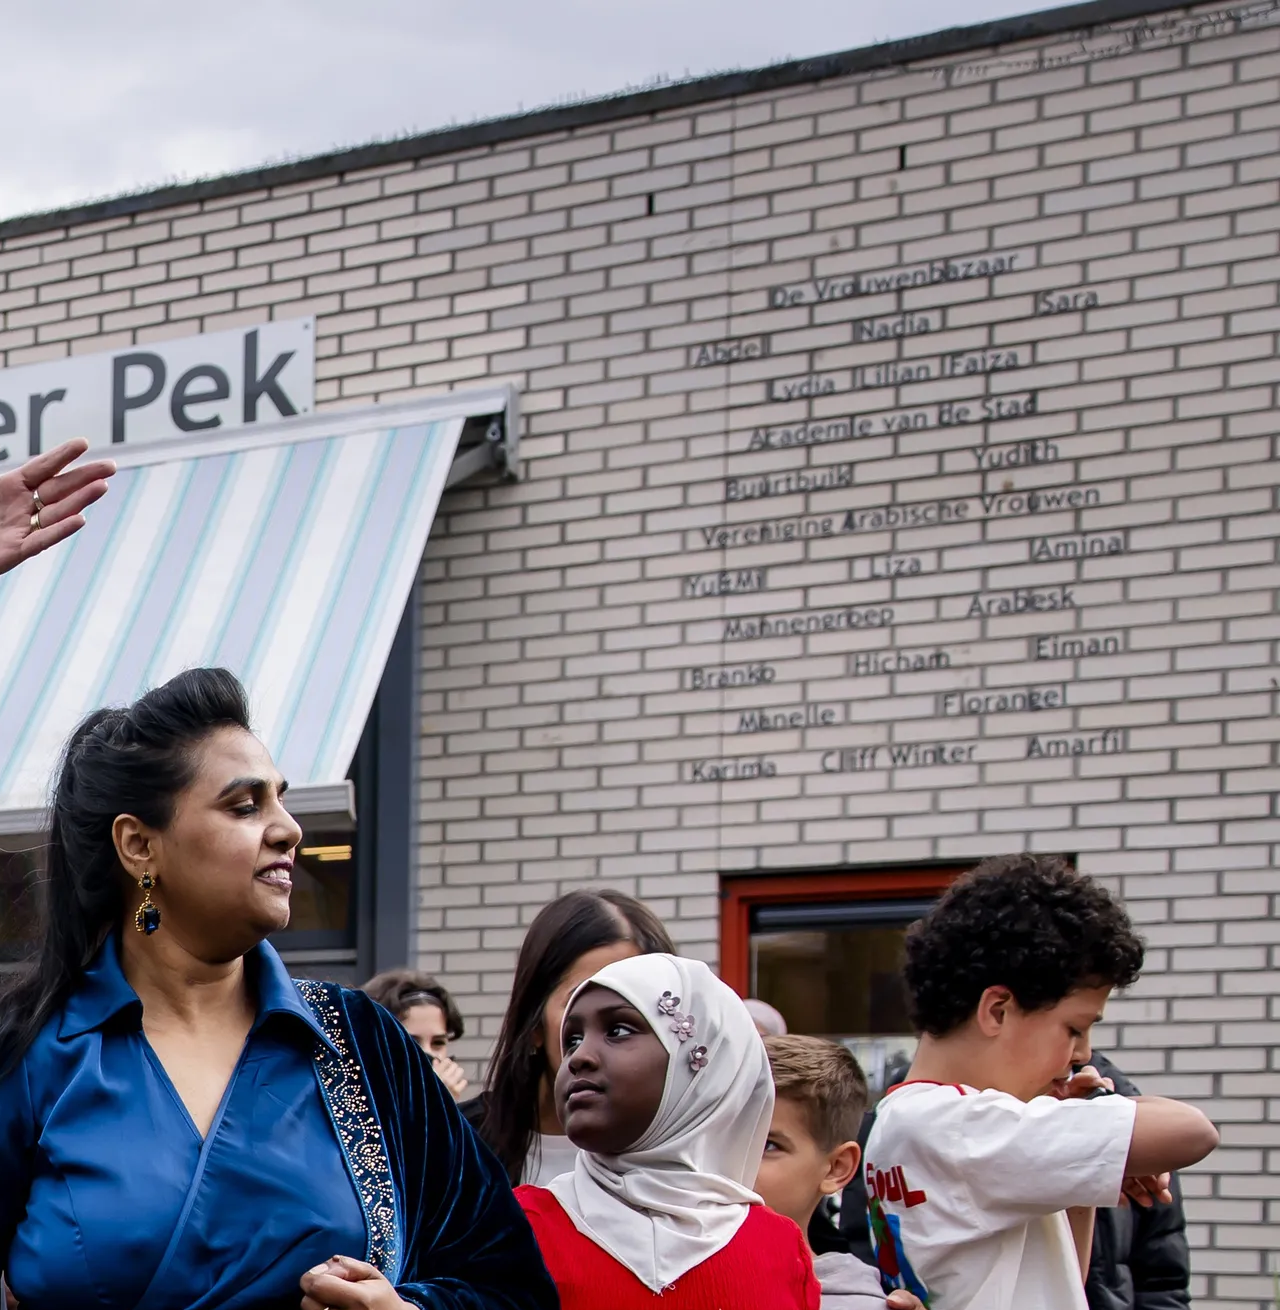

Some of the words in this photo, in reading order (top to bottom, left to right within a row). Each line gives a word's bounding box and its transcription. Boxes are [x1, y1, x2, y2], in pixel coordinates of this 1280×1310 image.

[771, 283, 804, 308] De
[814, 253, 1019, 300] Vrouwenbazaar
[1041, 290, 1099, 315] Sara
[858, 314, 931, 341] Nadia
[692, 334, 772, 368] Abdel
[112, 329, 298, 443] Pek
[770, 372, 835, 402] Lydia
[860, 355, 930, 389] Lilian
[947, 350, 1019, 376] Faiza
[747, 417, 873, 451] Academie
[883, 411, 928, 432] van
[938, 401, 971, 428] de
[981, 390, 1037, 422] Stad
[972, 438, 1059, 470] Yudith
[726, 463, 852, 501] Buurtbuik
[702, 513, 833, 548] Vereniging
[842, 497, 969, 532] Arabische
[980, 488, 1100, 518] Vrouwen
[1036, 532, 1124, 560] Amina
[871, 552, 922, 579] Liza
[966, 582, 1076, 619] Arabesk
[723, 605, 895, 642] Mannengroep
[854, 647, 952, 677] Hicham
[1036, 633, 1119, 661] Eiman
[691, 661, 777, 690] Branko
[942, 680, 1068, 715] Florangel
[738, 699, 836, 733] Manelle
[822, 749, 878, 774] Cliff
[889, 741, 978, 769] Winter
[1026, 727, 1118, 759] Amarfi
[691, 757, 778, 782] Karima
